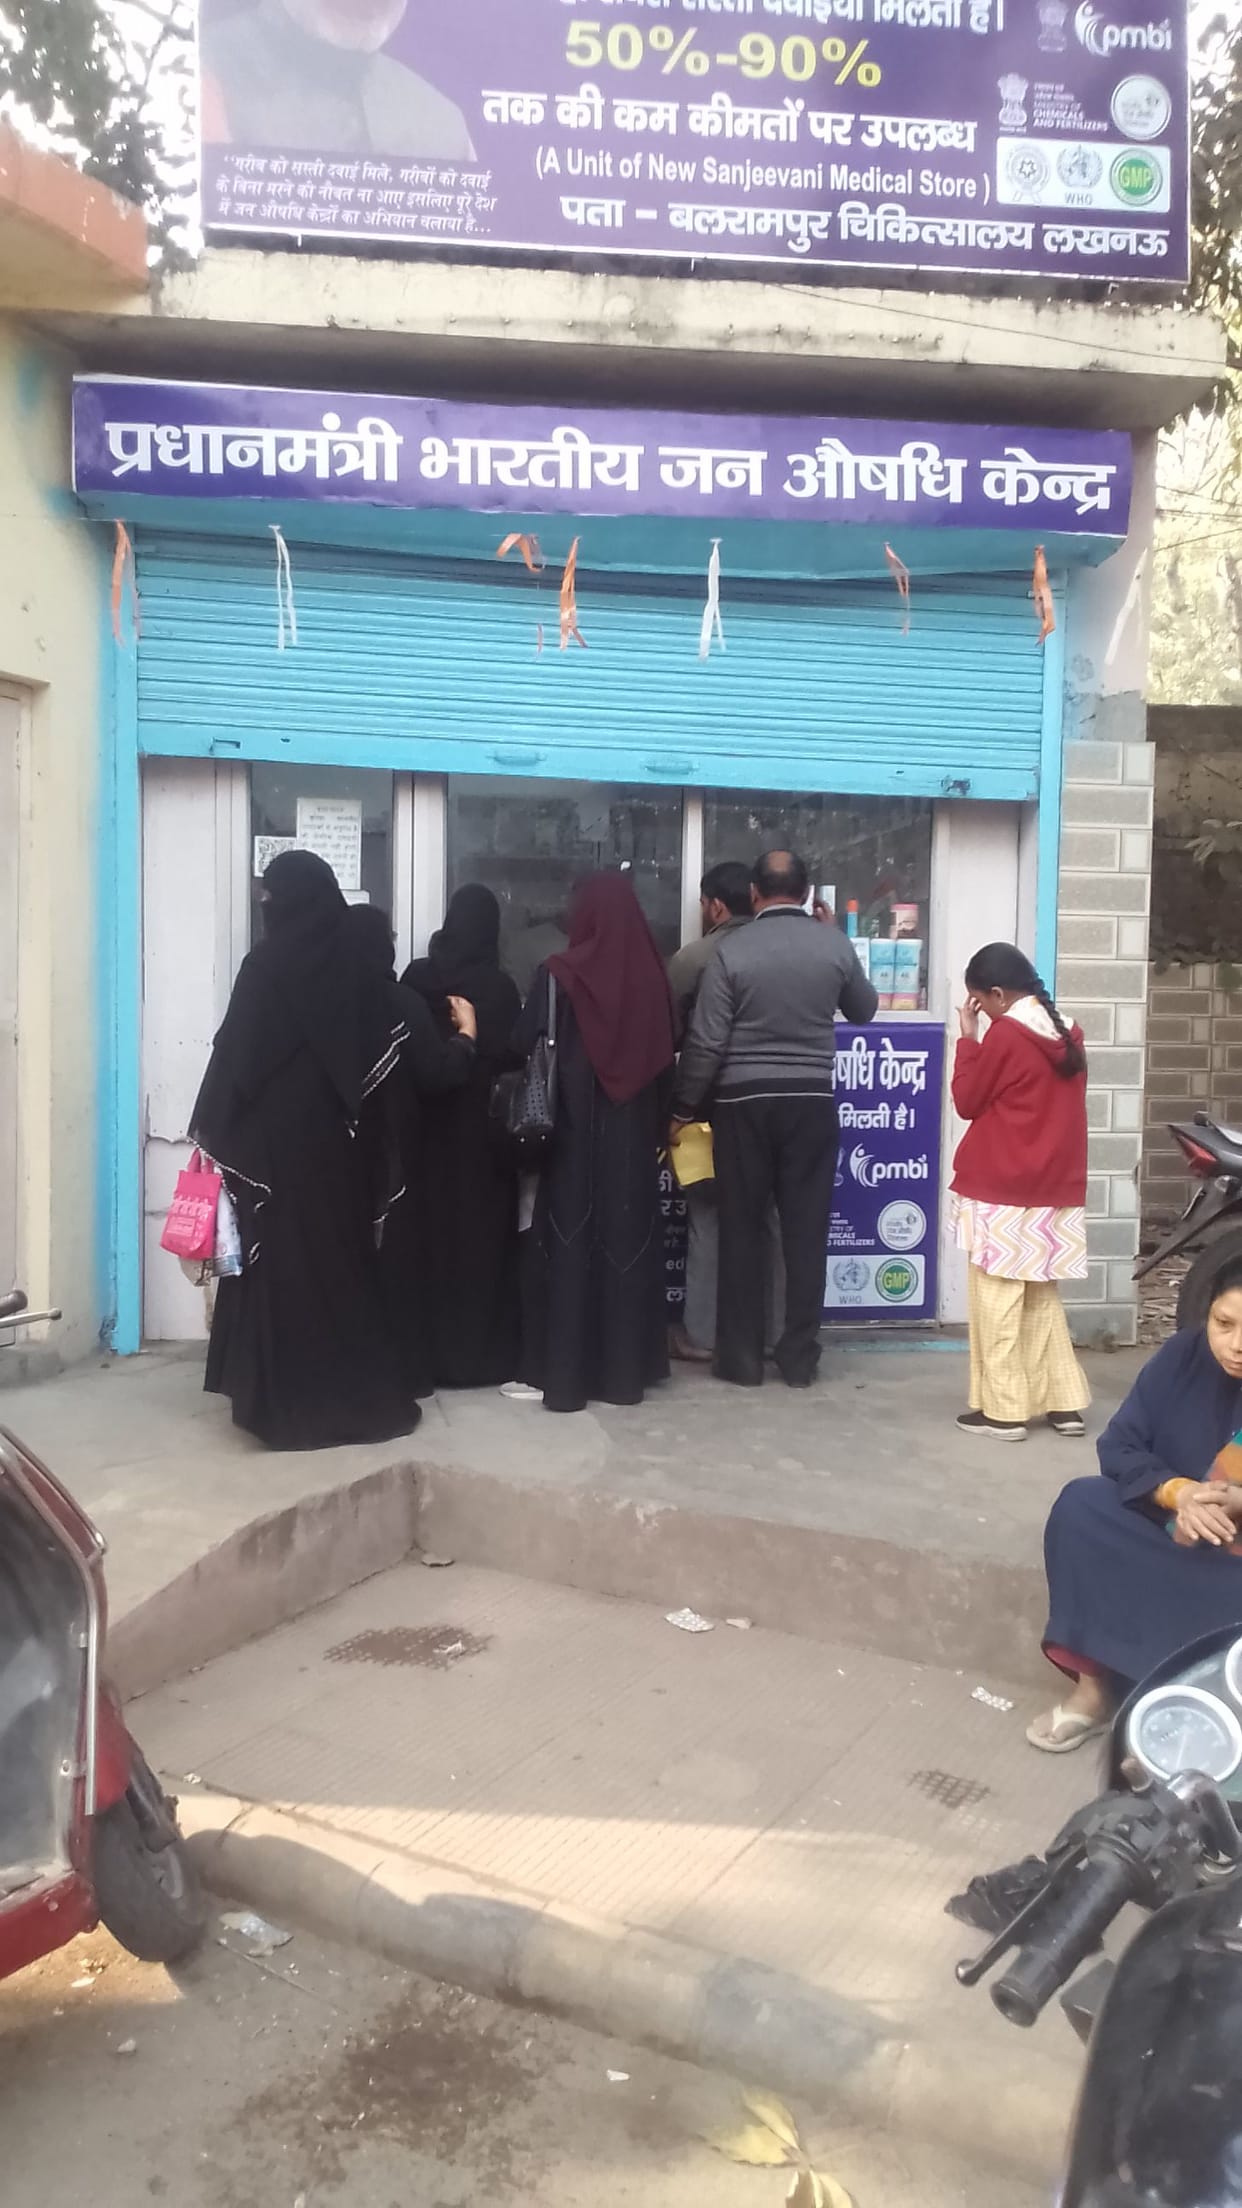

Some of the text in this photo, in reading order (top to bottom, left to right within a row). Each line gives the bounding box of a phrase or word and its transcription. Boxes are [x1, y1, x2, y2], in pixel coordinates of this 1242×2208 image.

[565, 19, 882, 88] 50%-90%
[1103, 18, 1172, 57] pmbi
[481, 83, 978, 153] तक की कम कीमतों पर उपलब्ध
[439, 167, 459, 187] को
[536, 146, 561, 181] (A
[567, 148, 614, 178] Unit
[619, 152, 643, 180] of
[648, 153, 697, 183] New
[702, 156, 823, 193] Sanjeevani
[830, 163, 913, 195] Medical
[920, 169, 977, 199] Store
[1120, 166, 1154, 190] GMP
[1064, 192, 1094, 206] WHO
[559, 196, 627, 228] पता
[667, 203, 833, 253] बलरामपुर
[838, 201, 1036, 250] चिकित्सालय
[1042, 223, 1170, 257] लखनऊ
[104, 412, 1118, 516] प्रधानमंत्री भारतीय जन औषधि केन्द्र
[879, 1037, 929, 1096] केन्द्र
[838, 1102, 892, 1130] मिलती
[871, 1153, 928, 1187] pmbi
[884, 1272, 911, 1290] GMP
[839, 1294, 863, 1305] WHO
